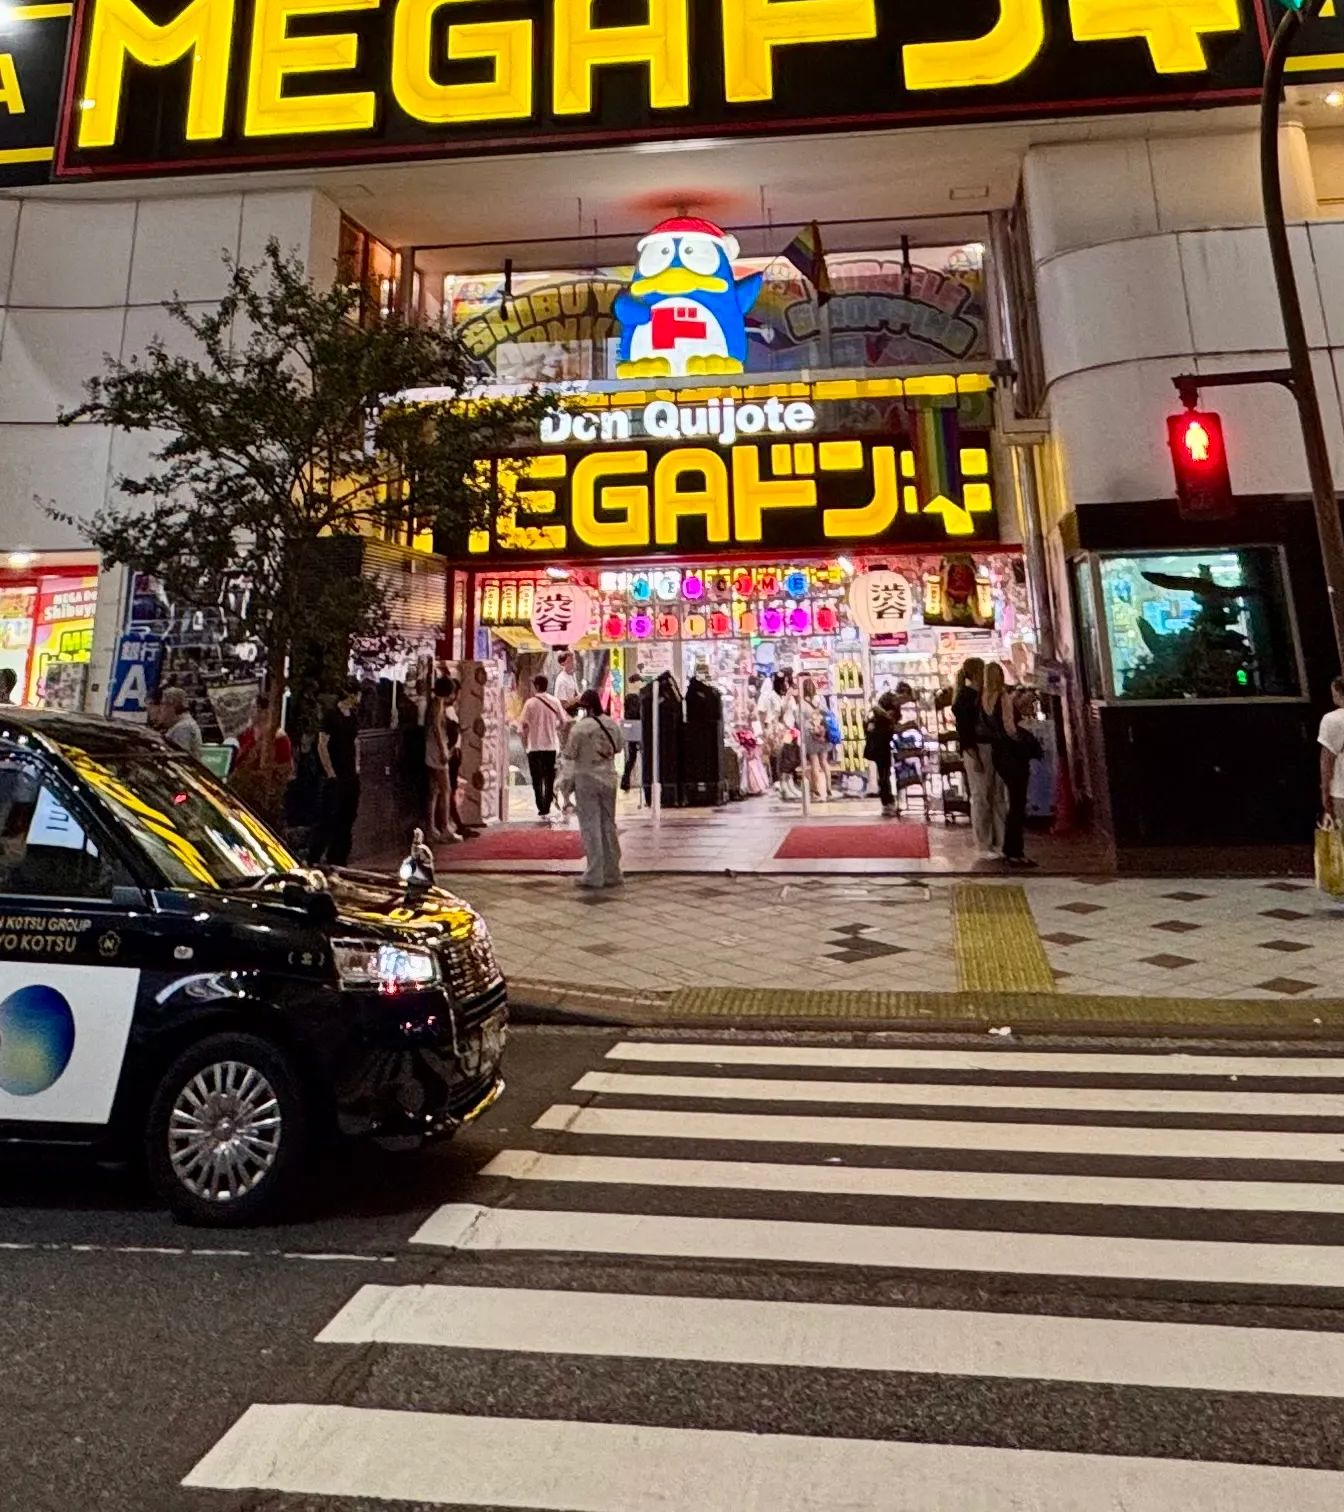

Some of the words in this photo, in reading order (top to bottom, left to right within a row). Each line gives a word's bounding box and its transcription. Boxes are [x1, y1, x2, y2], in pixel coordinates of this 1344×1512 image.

[461, 281, 623, 358] SHIBUY
[642, 396, 816, 445] Quijote
[535, 593, 573, 632] 渋谷
[870, 582, 908, 620] 渋谷
[121, 641, 160, 662] 銀行
[5, 917, 47, 932] KOTSU
[47, 917, 93, 933] GROUP
[20, 933, 78, 953] KOTSU
